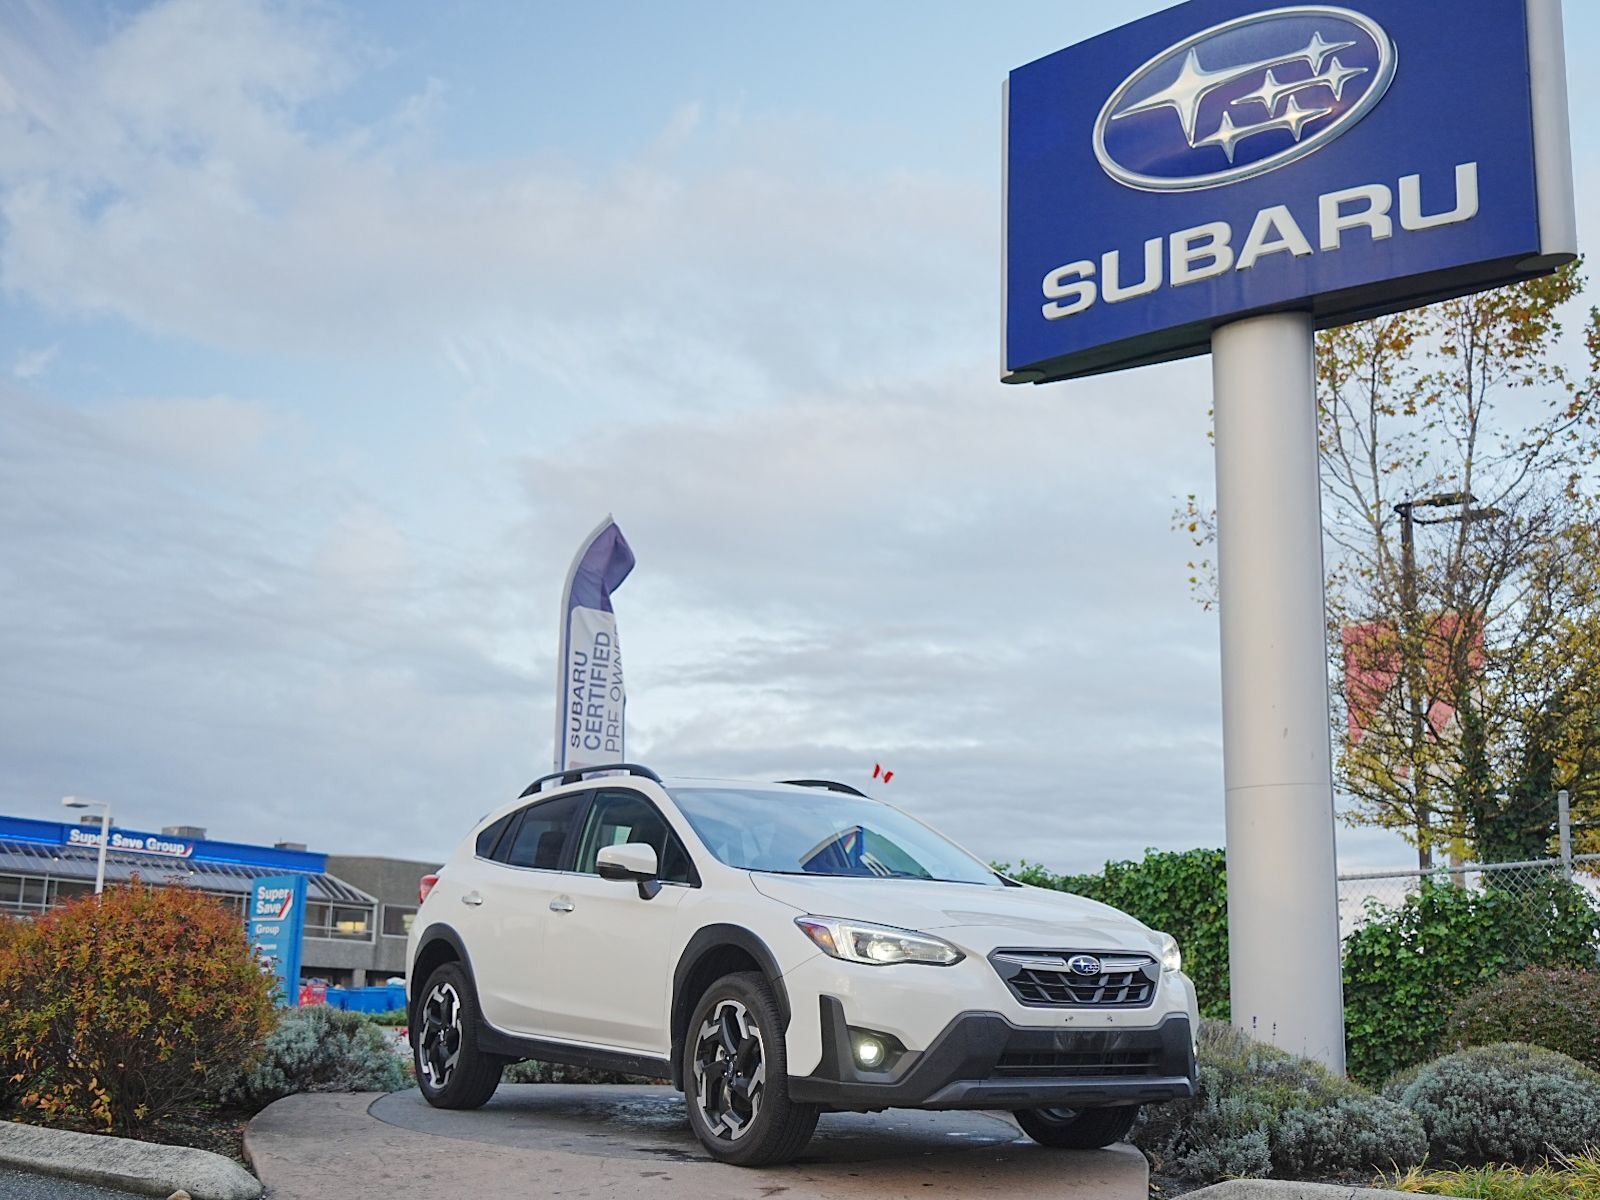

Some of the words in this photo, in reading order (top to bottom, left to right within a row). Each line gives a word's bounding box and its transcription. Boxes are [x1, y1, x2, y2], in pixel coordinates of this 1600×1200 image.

[1041, 162, 1479, 321] SUBARU
[610, 623, 623, 702] OWN
[571, 651, 588, 749] SUBARU
[584, 632, 611, 751] CERTIFIED
[69, 829, 110, 847] Supe
[112, 833, 144, 850] Save
[146, 837, 185, 857] Group
[256, 901, 282, 915] Save
[257, 886, 290, 902] Super
[255, 924, 280, 936] Group
